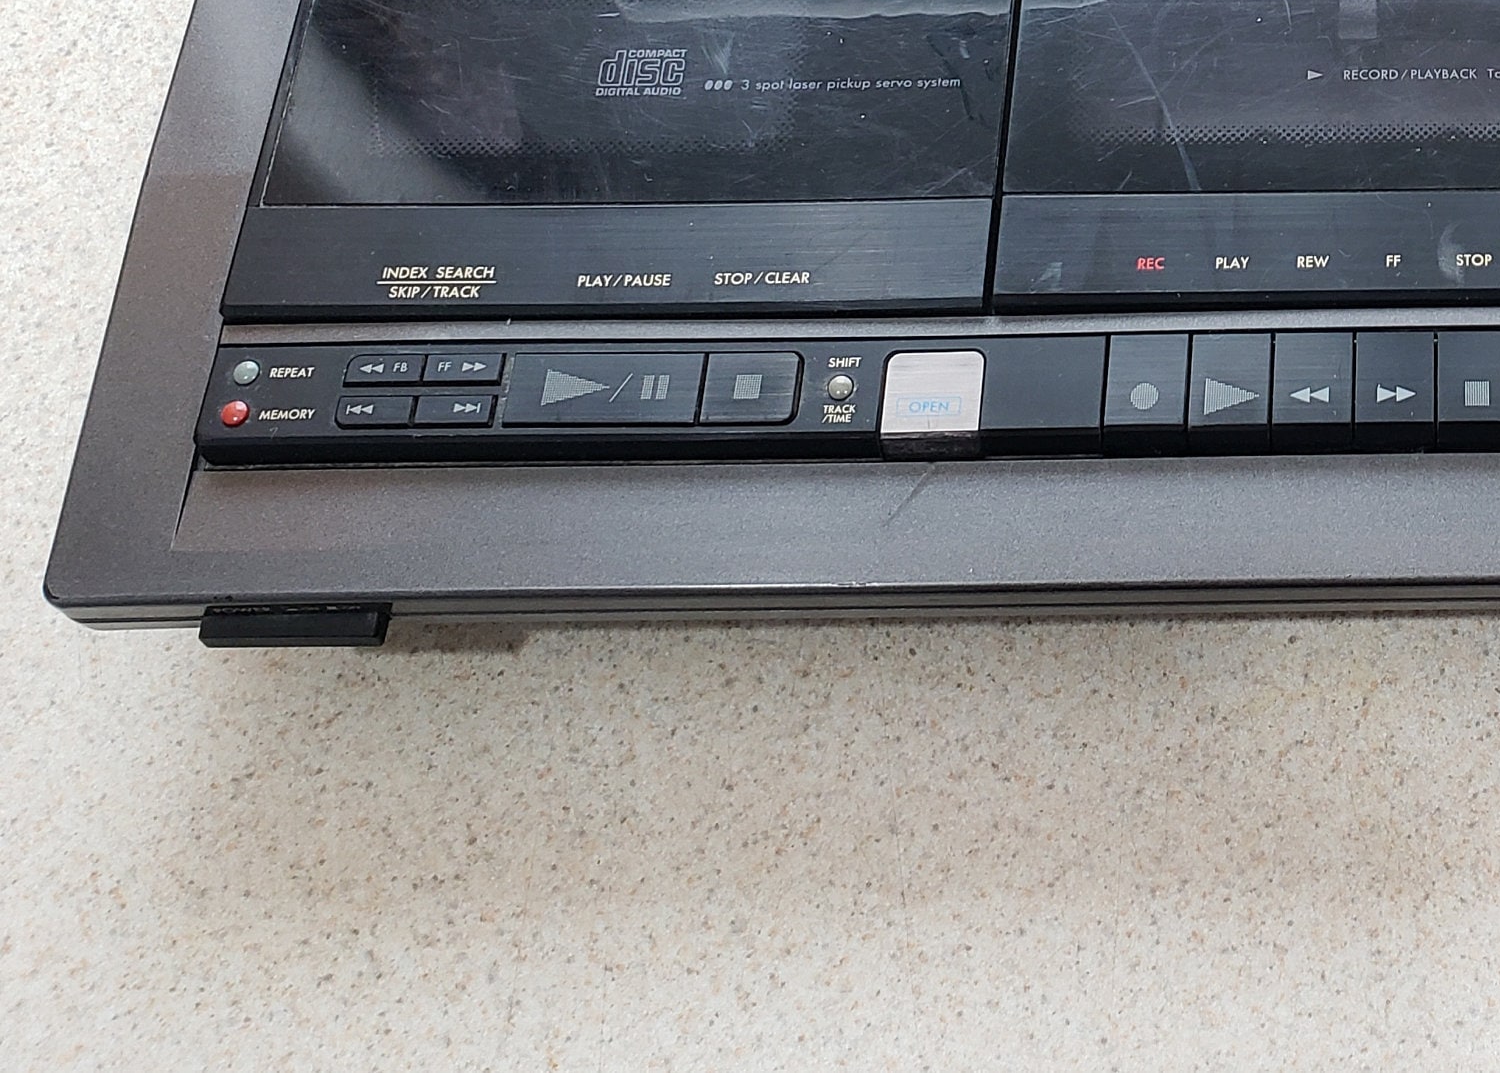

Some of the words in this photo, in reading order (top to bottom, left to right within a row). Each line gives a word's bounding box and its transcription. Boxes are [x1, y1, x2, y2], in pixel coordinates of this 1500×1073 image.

[628, 49, 687, 59] COMPACT
[597, 50, 687, 87] disc
[595, 87, 640, 96] DIGITAL
[643, 86, 682, 96] AUDIO
[741, 80, 749, 90] 3
[755, 79, 785, 92] spot
[788, 78, 821, 90] laser
[827, 77, 871, 92] pickup
[875, 78, 912, 89] servo
[917, 77, 961, 90] system
[1136, 257, 1165, 270] REC
[1214, 256, 1250, 270] PLAY
[1296, 255, 1329, 269] REW
[1385, 255, 1401, 268] FF
[1456, 253, 1492, 267] STOP
[382, 267, 429, 279] INDEX
[436, 266, 495, 279] SEARCH
[714, 271, 811, 286] STOP/CLEAR
[577, 273, 672, 287] PLAY/PAUSE
[388, 286, 481, 299] SKIP/TRACK
[392, 362, 408, 373] FB
[437, 361, 453, 373] FF
[827, 356, 861, 368] SHIFT
[269, 367, 314, 379] REPEAT
[822, 404, 857, 415] TRACK
[909, 399, 951, 413] OPEN
[259, 409, 315, 422] MEMORY
[821, 413, 853, 424] /TIME
